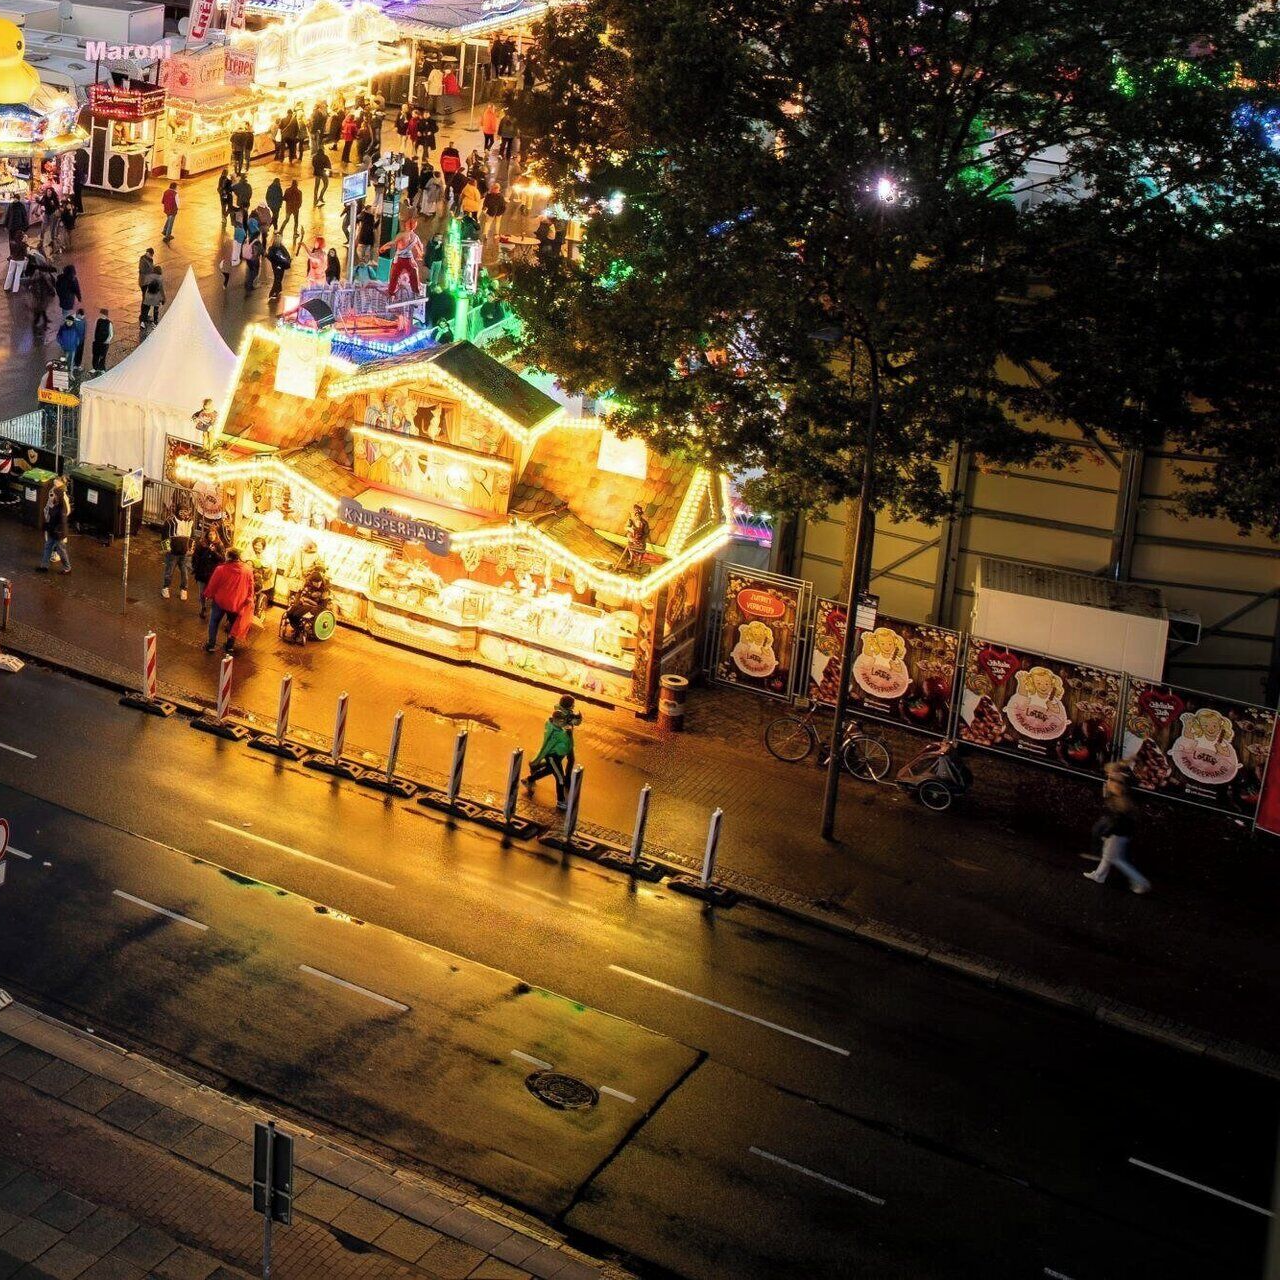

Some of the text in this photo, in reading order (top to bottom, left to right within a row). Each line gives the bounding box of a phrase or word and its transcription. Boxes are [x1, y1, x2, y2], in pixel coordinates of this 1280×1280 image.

[85, 40, 172, 61] Maroni
[41, 391, 53, 400] WC
[344, 507, 445, 544] KNUSPERHAUS
